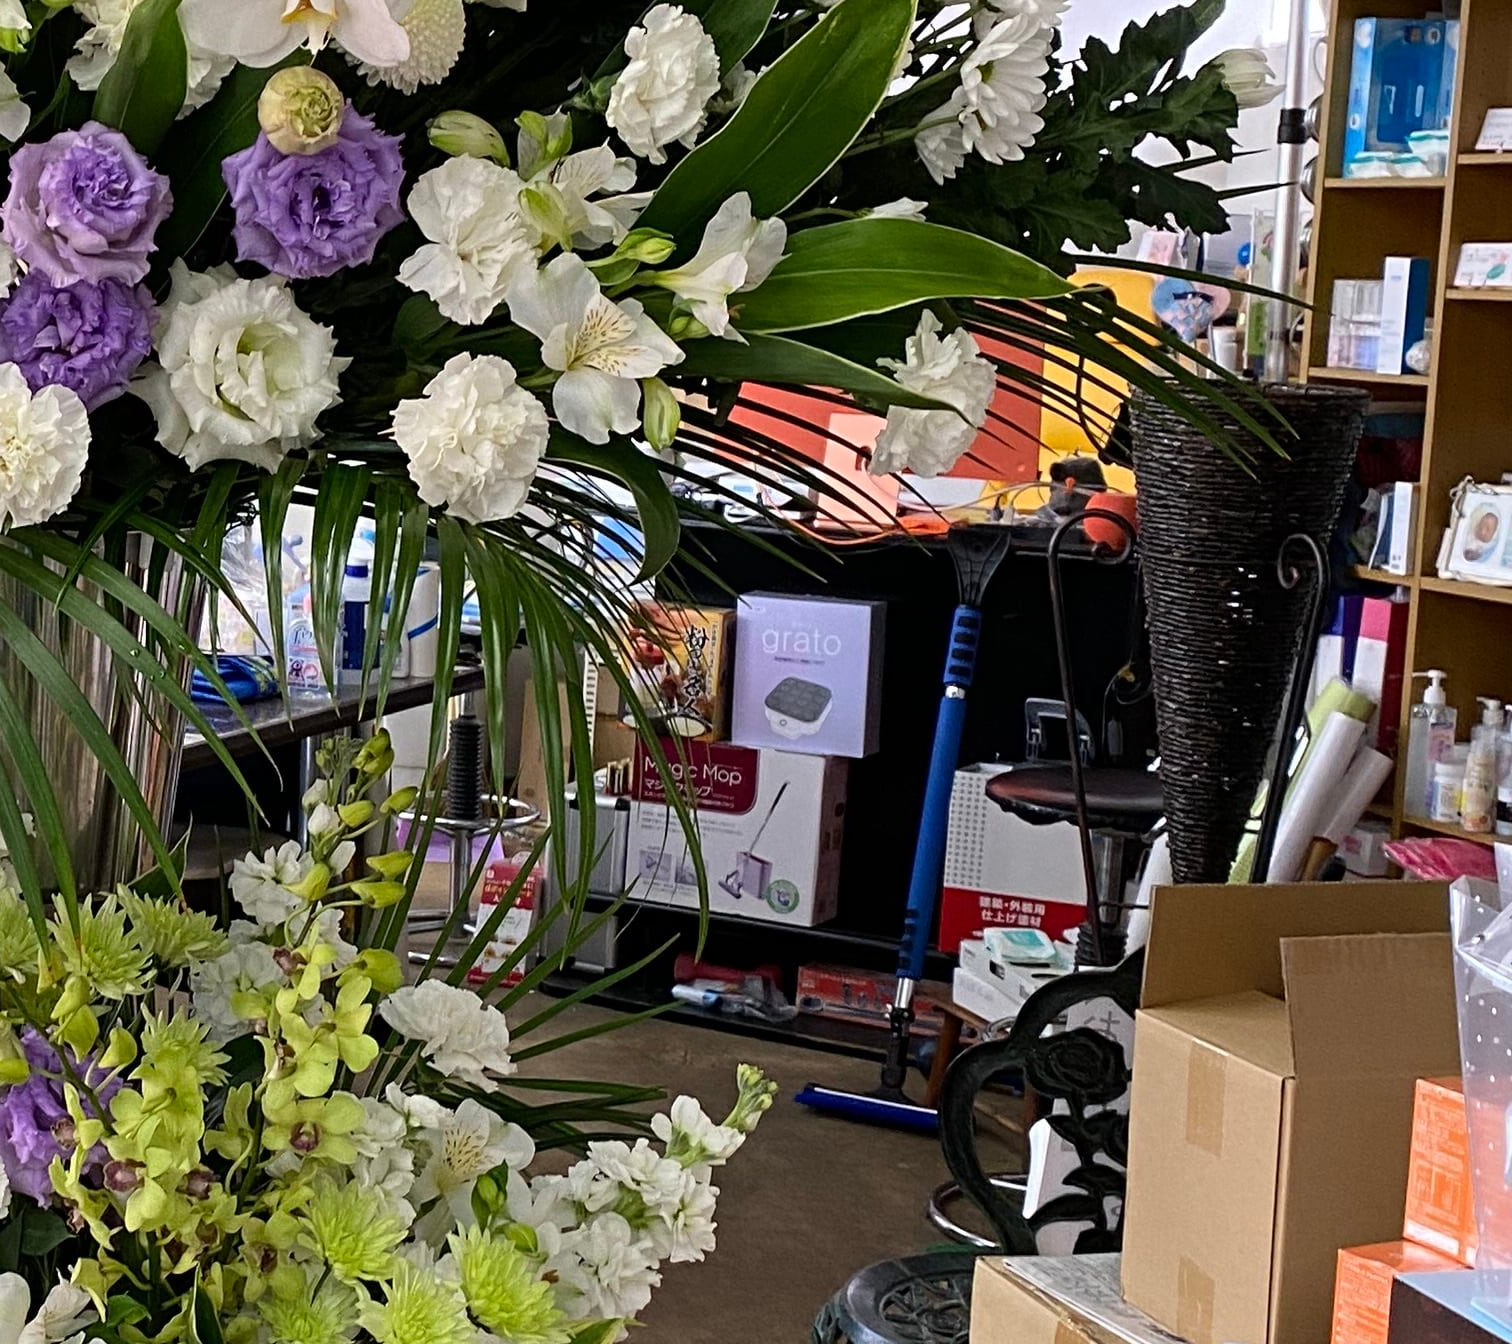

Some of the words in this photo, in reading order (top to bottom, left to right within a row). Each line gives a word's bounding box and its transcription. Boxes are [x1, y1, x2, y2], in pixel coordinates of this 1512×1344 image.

[761, 627, 843, 656] grato
[644, 756, 698, 781] Mgc
[703, 763, 743, 787] Mop
